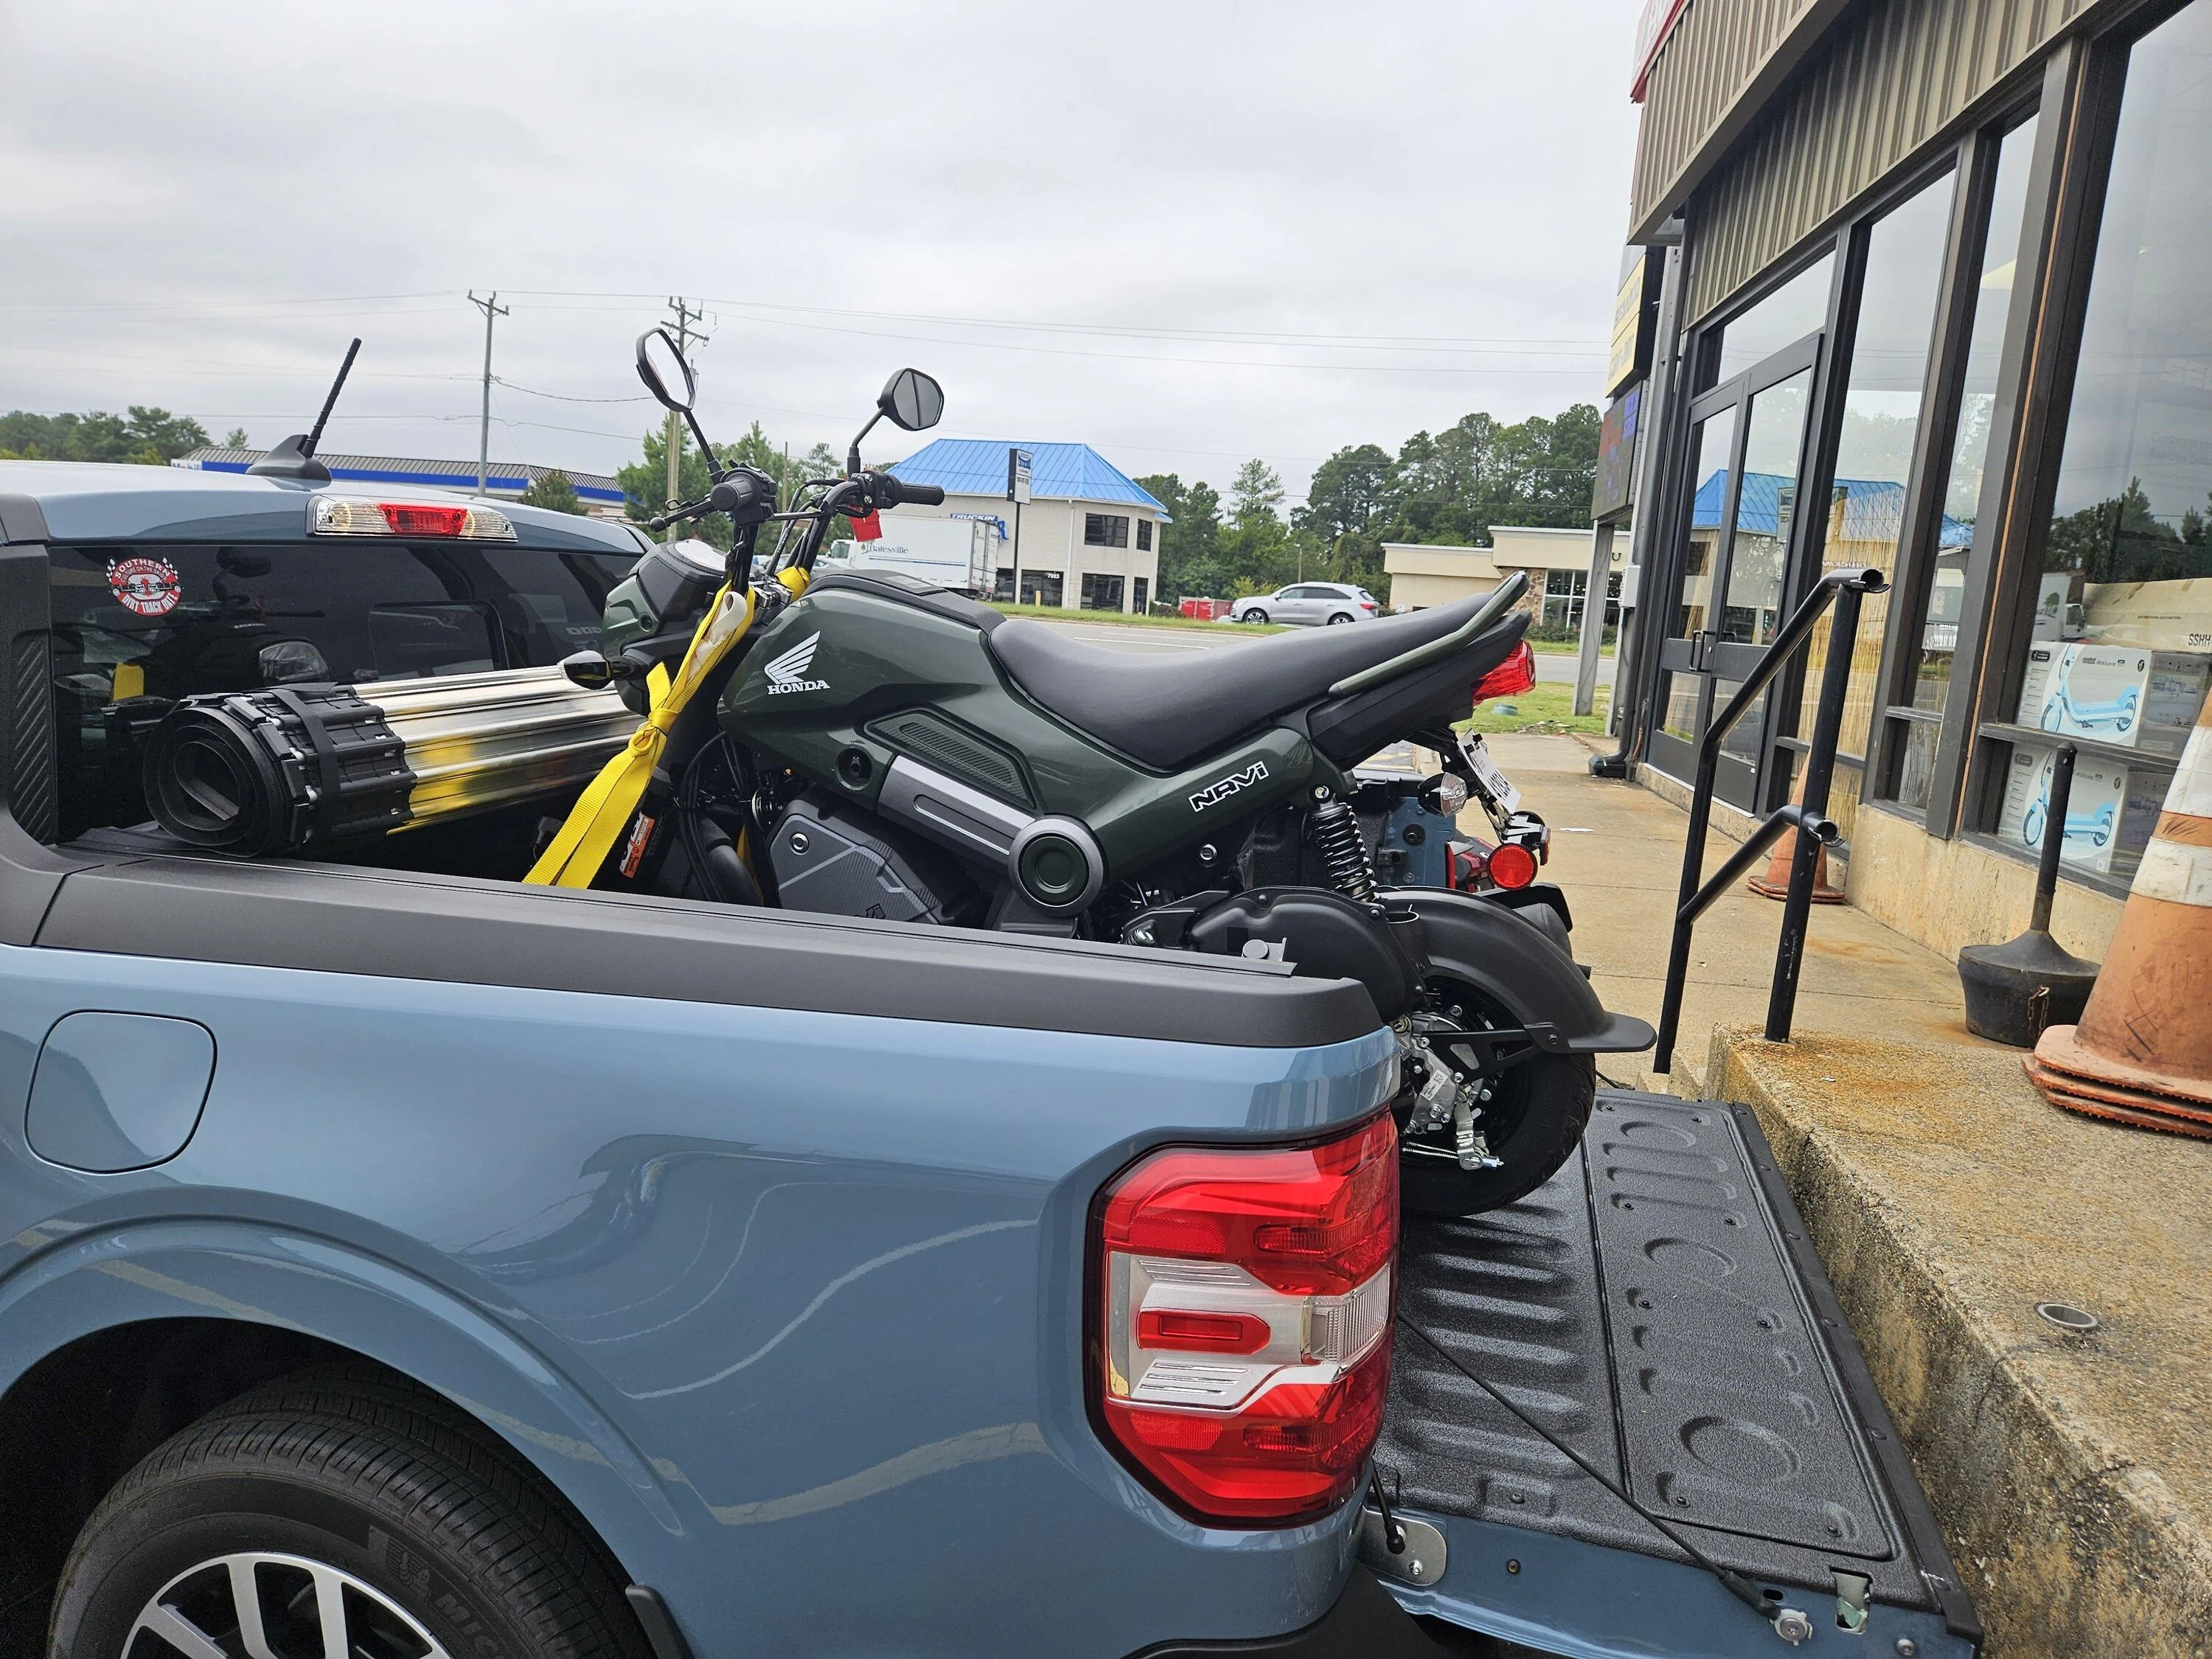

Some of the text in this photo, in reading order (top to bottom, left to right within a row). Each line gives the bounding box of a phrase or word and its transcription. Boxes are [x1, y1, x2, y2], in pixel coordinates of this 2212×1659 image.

[869, 545, 908, 554] Batesville
[115, 559, 170, 579] SOUTHERN
[122, 594, 140, 612] DIRT
[141, 600, 163, 613] TRACK
[767, 680, 831, 695] HONDA
